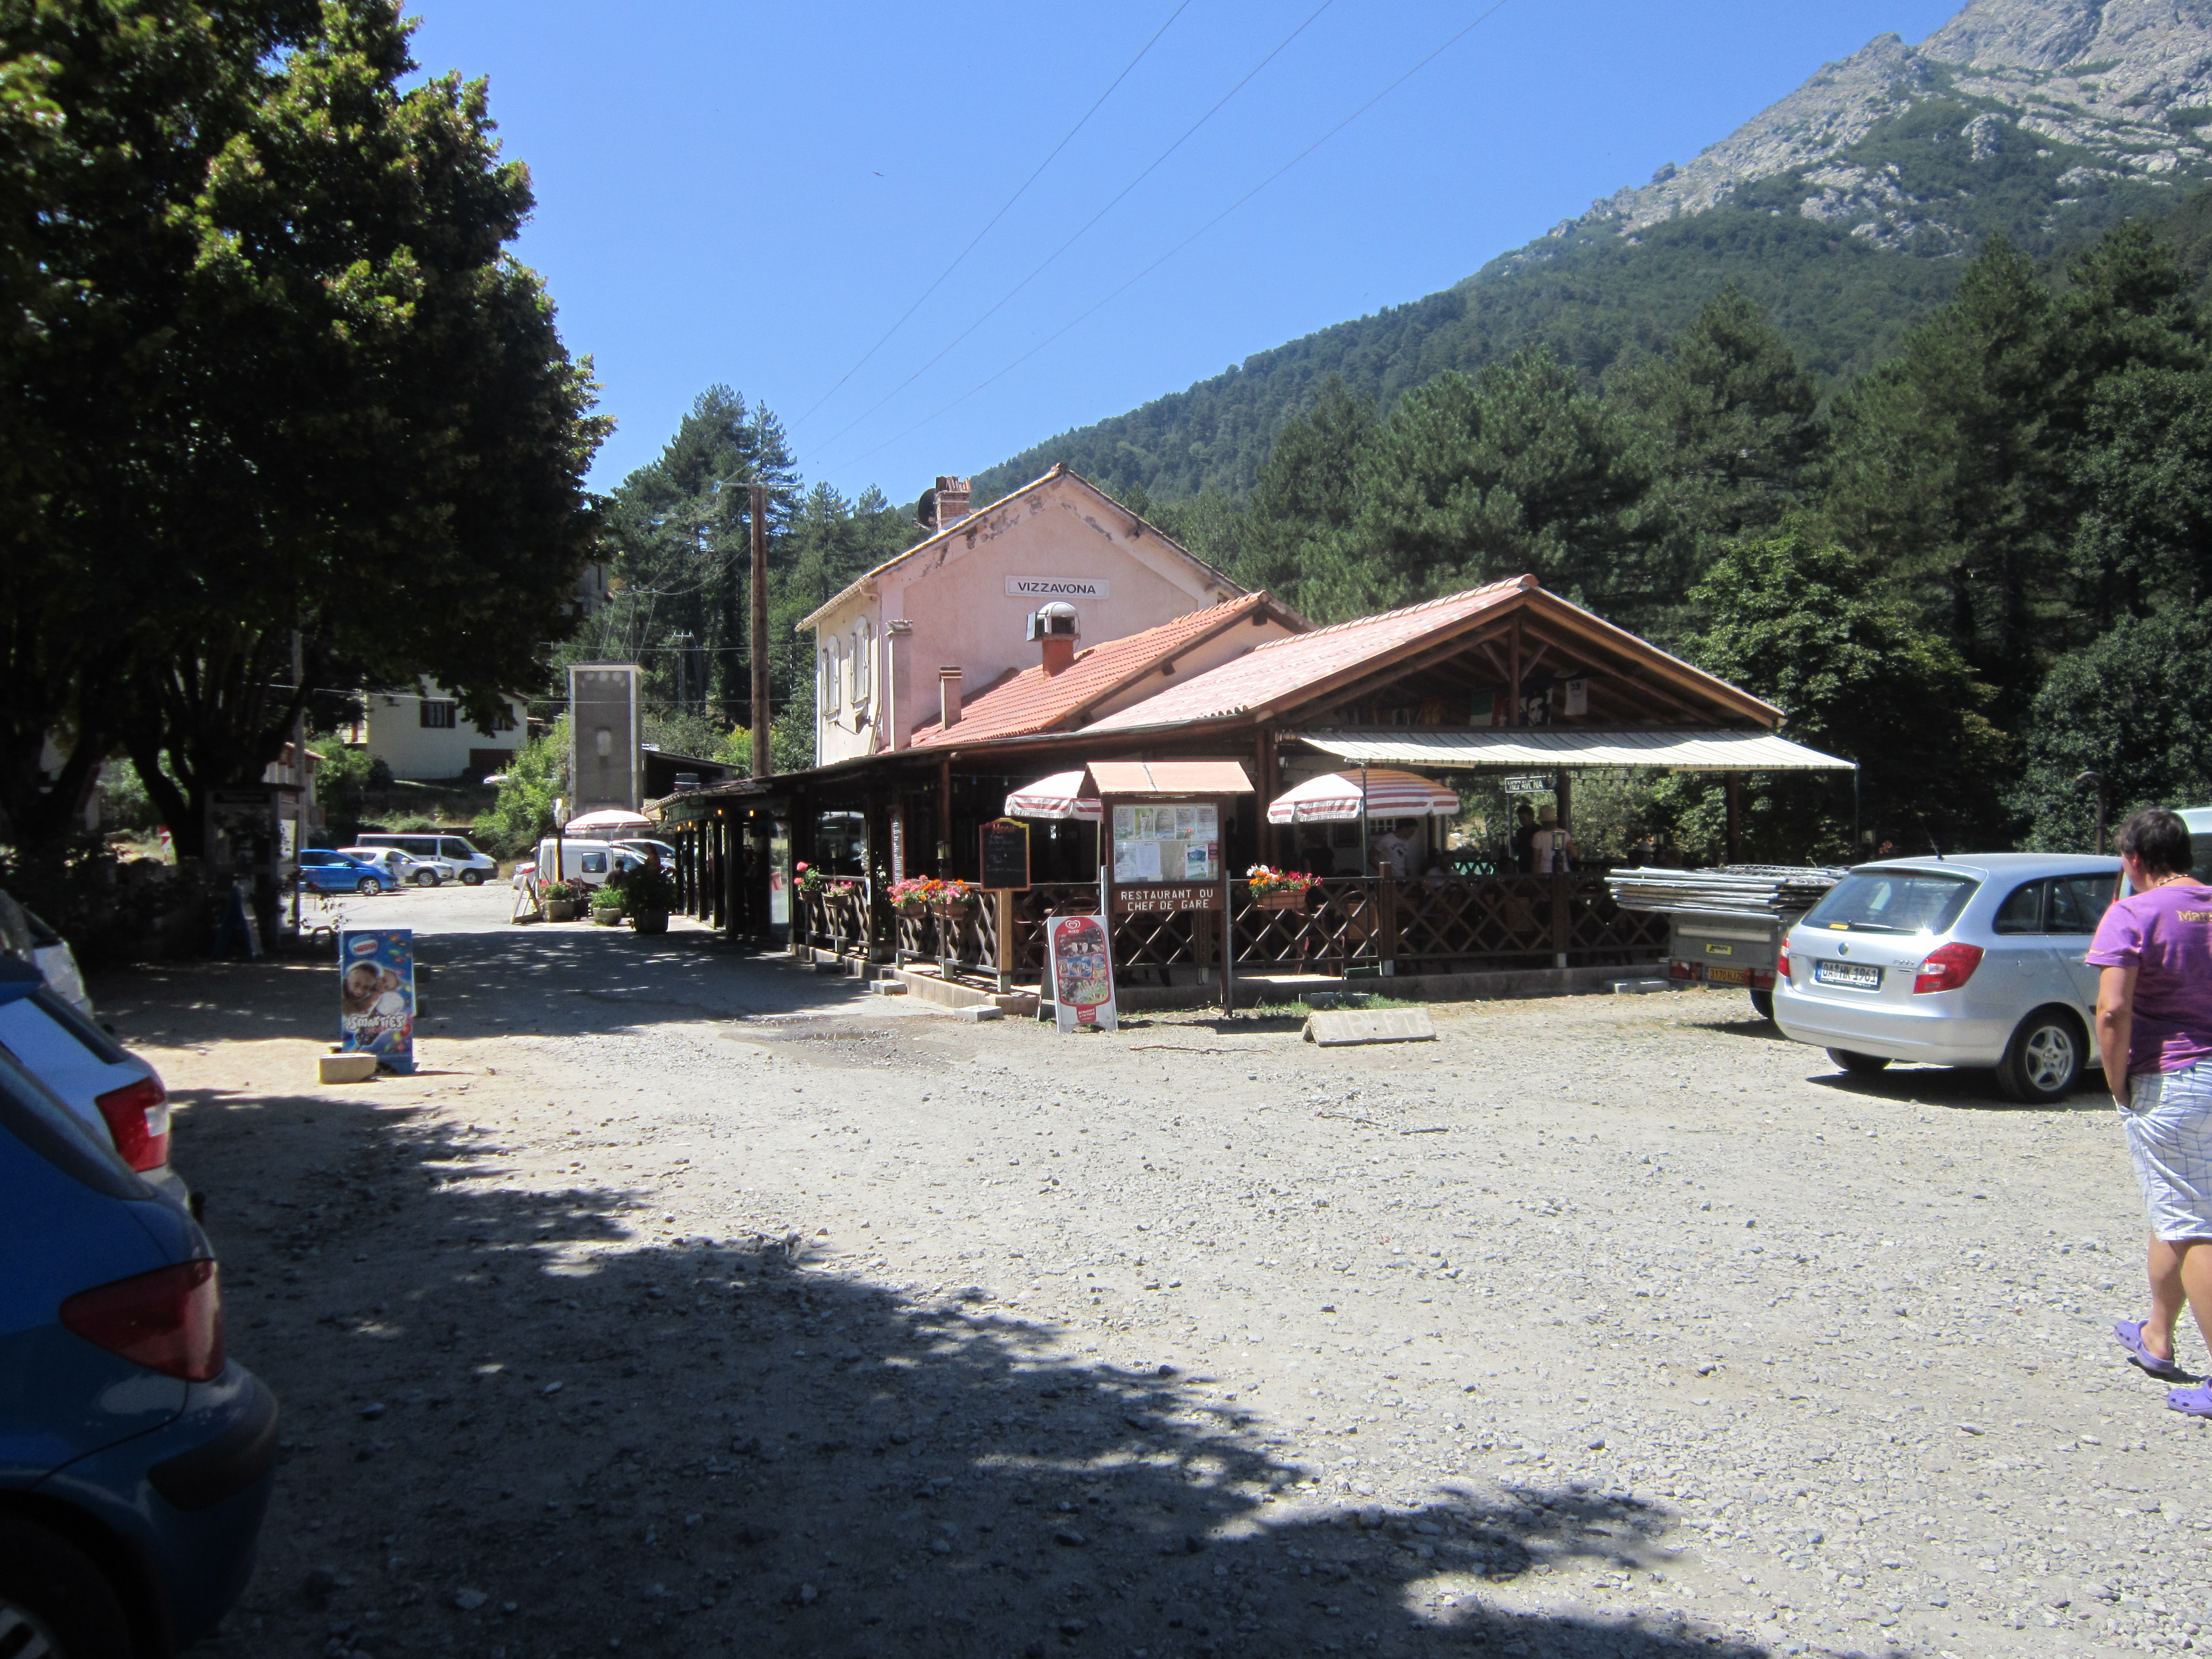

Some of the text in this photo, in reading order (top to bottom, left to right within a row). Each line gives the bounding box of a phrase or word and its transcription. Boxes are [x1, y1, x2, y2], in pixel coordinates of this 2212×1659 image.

[1017, 582, 1096, 594] VIZZAVONA
[1121, 889, 1214, 901] RESTAURANT DU
[1128, 899, 1210, 911] CHEF DE GARE
